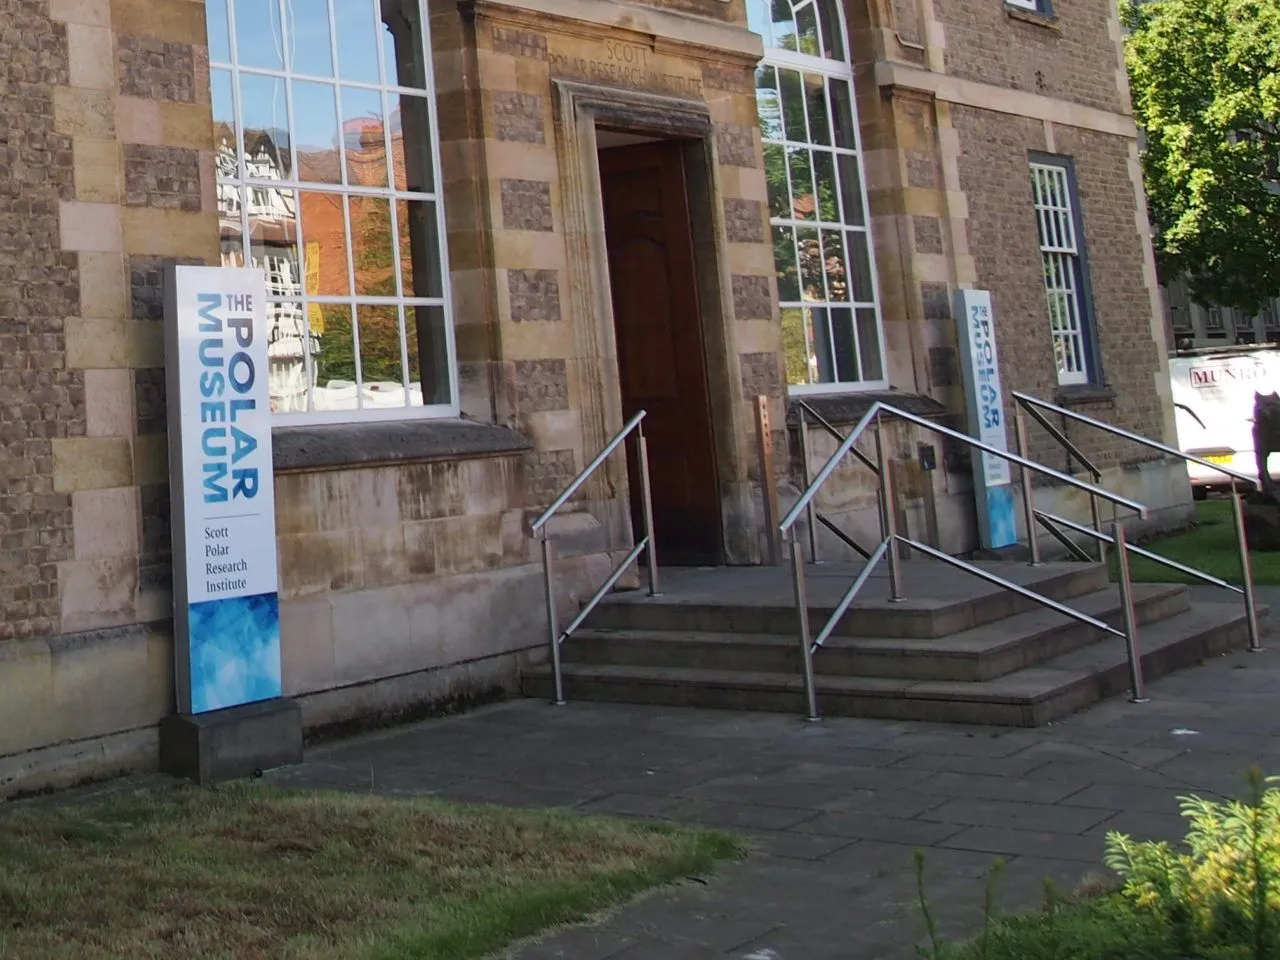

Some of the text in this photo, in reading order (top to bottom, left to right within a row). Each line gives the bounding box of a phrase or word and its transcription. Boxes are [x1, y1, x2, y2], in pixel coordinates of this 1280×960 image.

[606, 40, 649, 66] SCOTT
[590, 61, 646, 89] RESEARCH
[226, 293, 253, 312] THE
[970, 305, 993, 430] MUSEUM
[980, 319, 1001, 429] POLAR
[196, 292, 229, 504] MUSEUM
[226, 317, 260, 503] POLAR
[204, 526, 230, 541] Scott
[205, 544, 231, 558] Polar
[206, 559, 248, 575] Research
[206, 578, 248, 593] Institute
